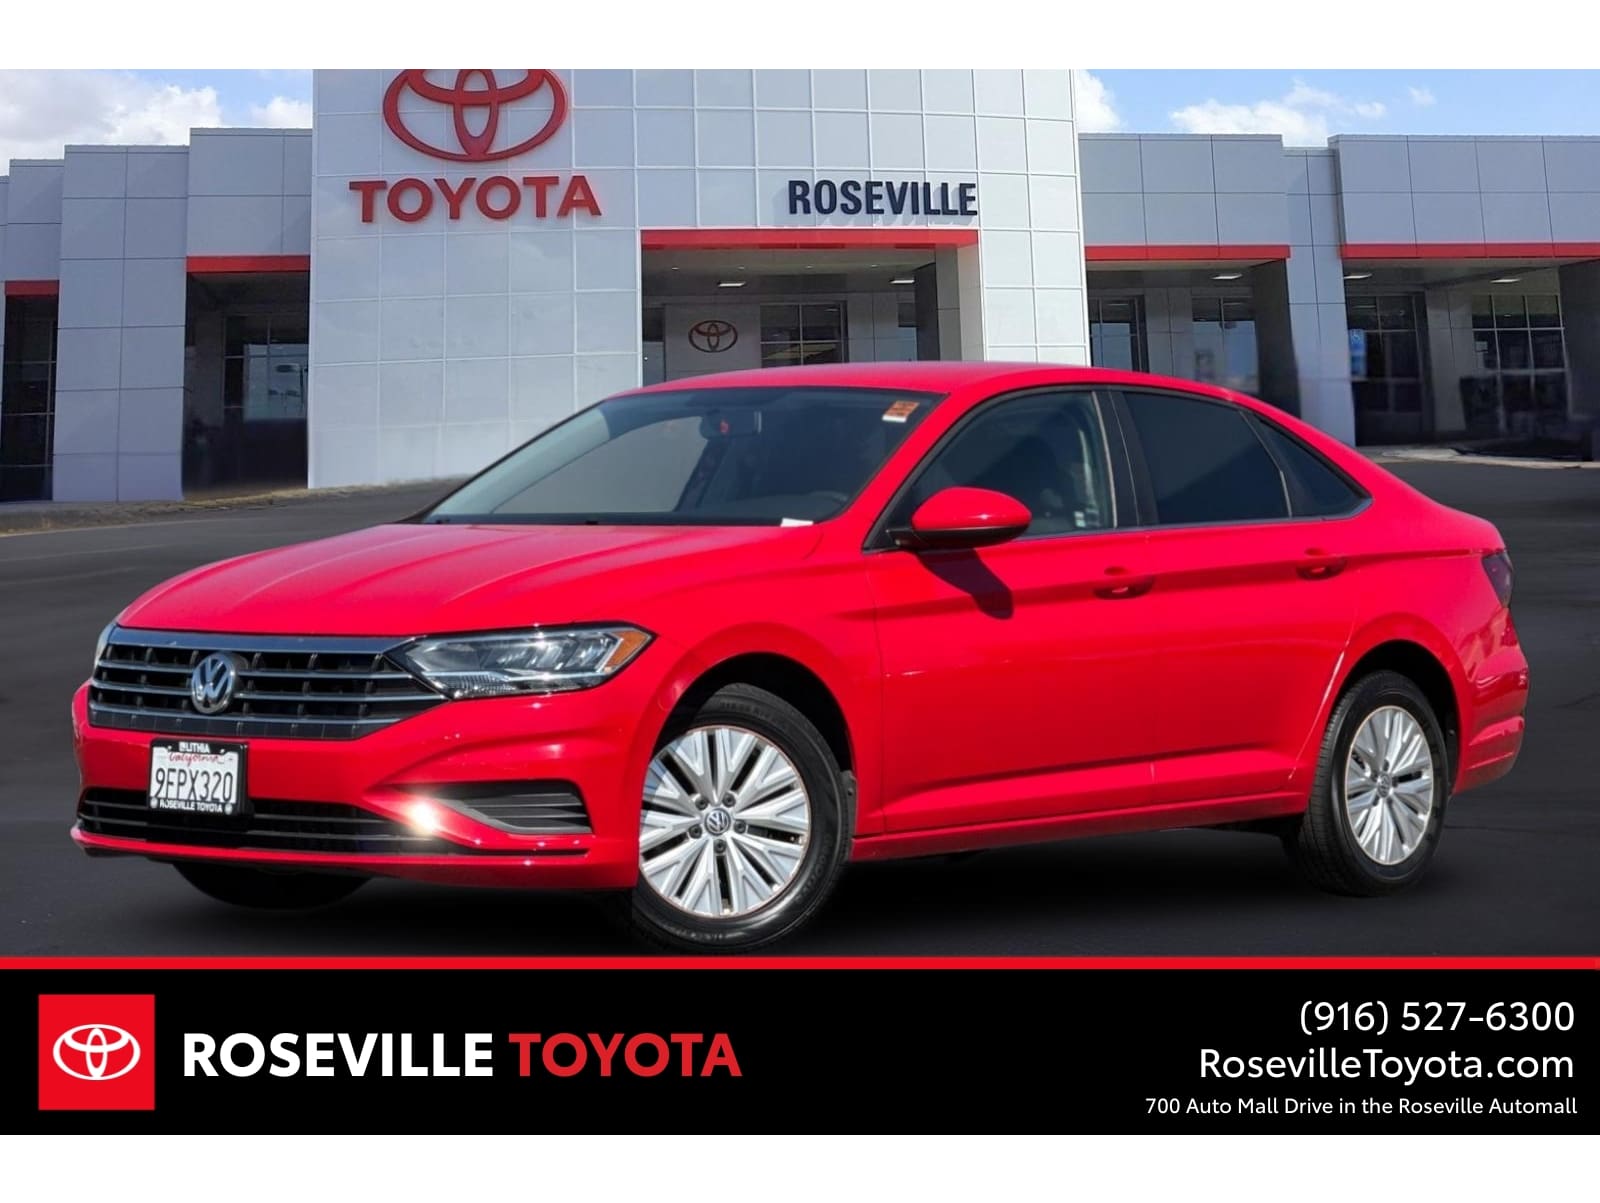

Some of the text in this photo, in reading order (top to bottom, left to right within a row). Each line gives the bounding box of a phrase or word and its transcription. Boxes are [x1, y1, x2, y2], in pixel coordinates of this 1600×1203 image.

[349, 176, 601, 223] TOYOTA
[788, 179, 978, 217] ROSEVILLE
[155, 768, 234, 803] 9FPX320
[159, 799, 223, 813] ROSEVILLE TOYOTA
